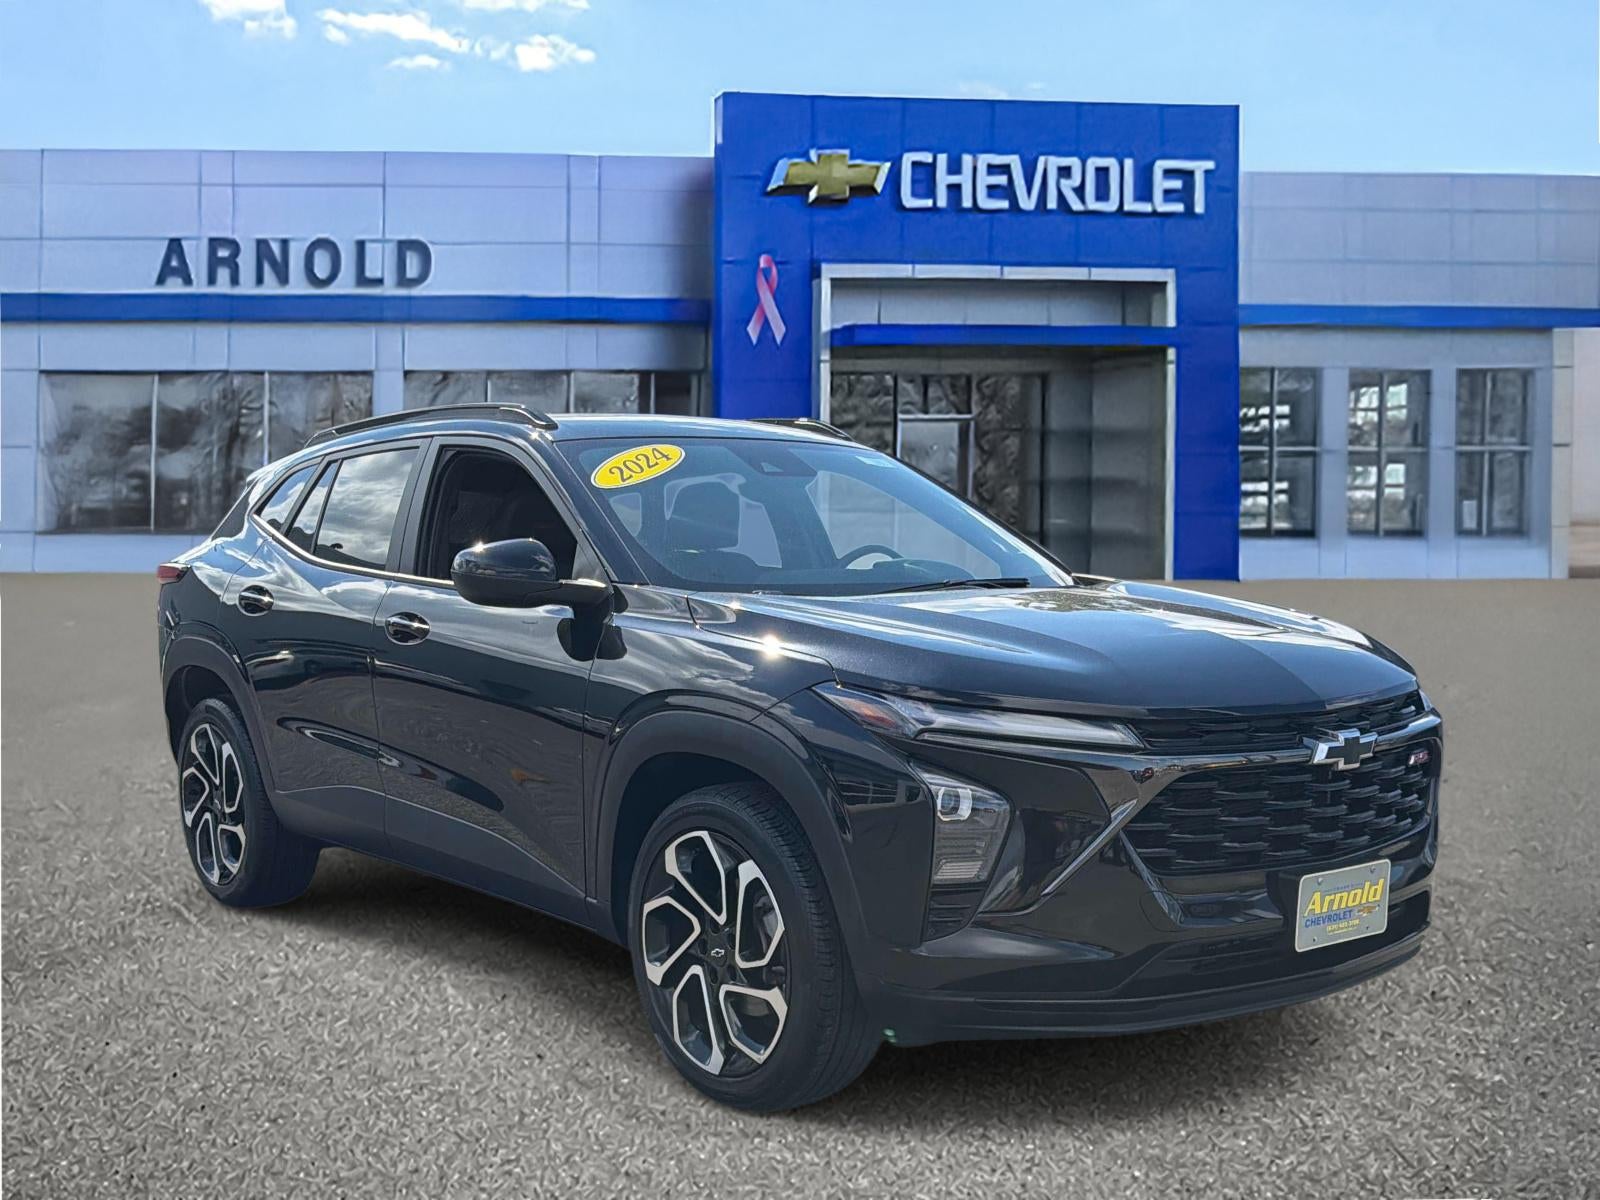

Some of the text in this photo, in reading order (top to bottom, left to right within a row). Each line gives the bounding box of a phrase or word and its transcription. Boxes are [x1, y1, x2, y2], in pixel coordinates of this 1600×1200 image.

[900, 151, 1216, 214] CHEVROLET
[155, 237, 433, 289] ARNOLD
[608, 447, 673, 483] 2024
[1303, 878, 1385, 918] Arnold
[1304, 909, 1354, 929] CHEVROLET
